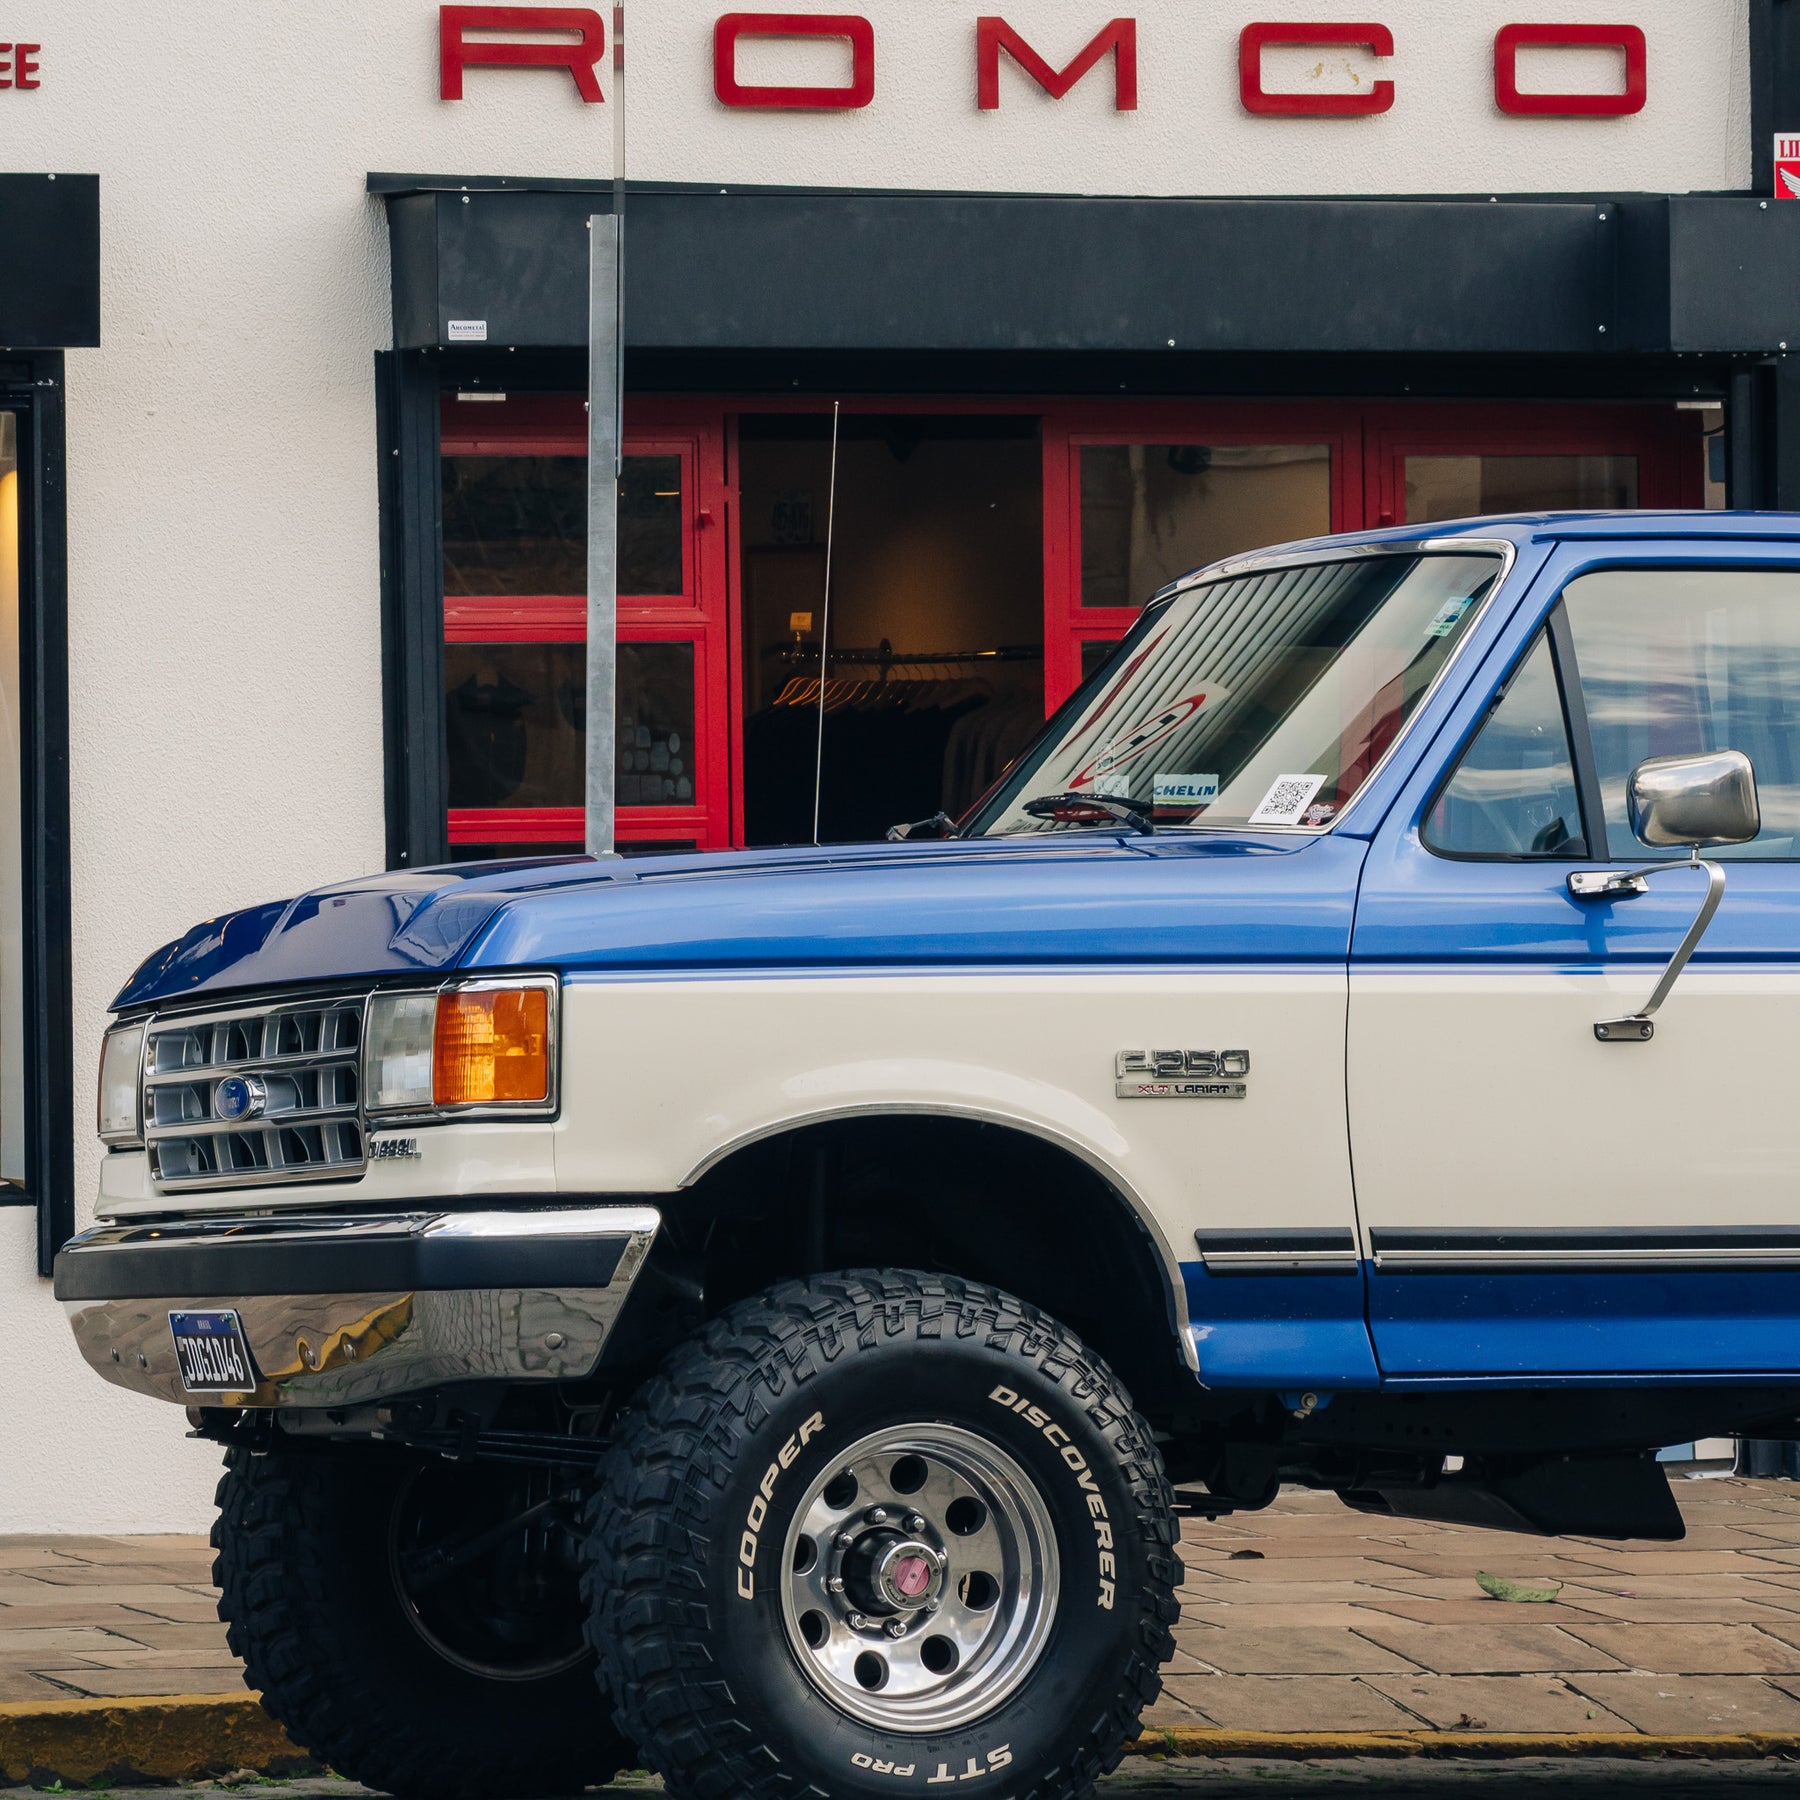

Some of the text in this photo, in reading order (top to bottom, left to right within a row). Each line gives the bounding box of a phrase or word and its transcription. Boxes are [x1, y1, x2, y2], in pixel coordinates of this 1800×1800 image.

[440, 5, 1647, 118] ROMCO
[1138, 1085, 1230, 1094] XLT LARIAT
[182, 1337, 244, 1382] JDG1D46
[737, 1411, 826, 1600] COOPER
[988, 1385, 1116, 1610] DISCOVERER
[851, 1743, 1013, 1784] STT PRO
